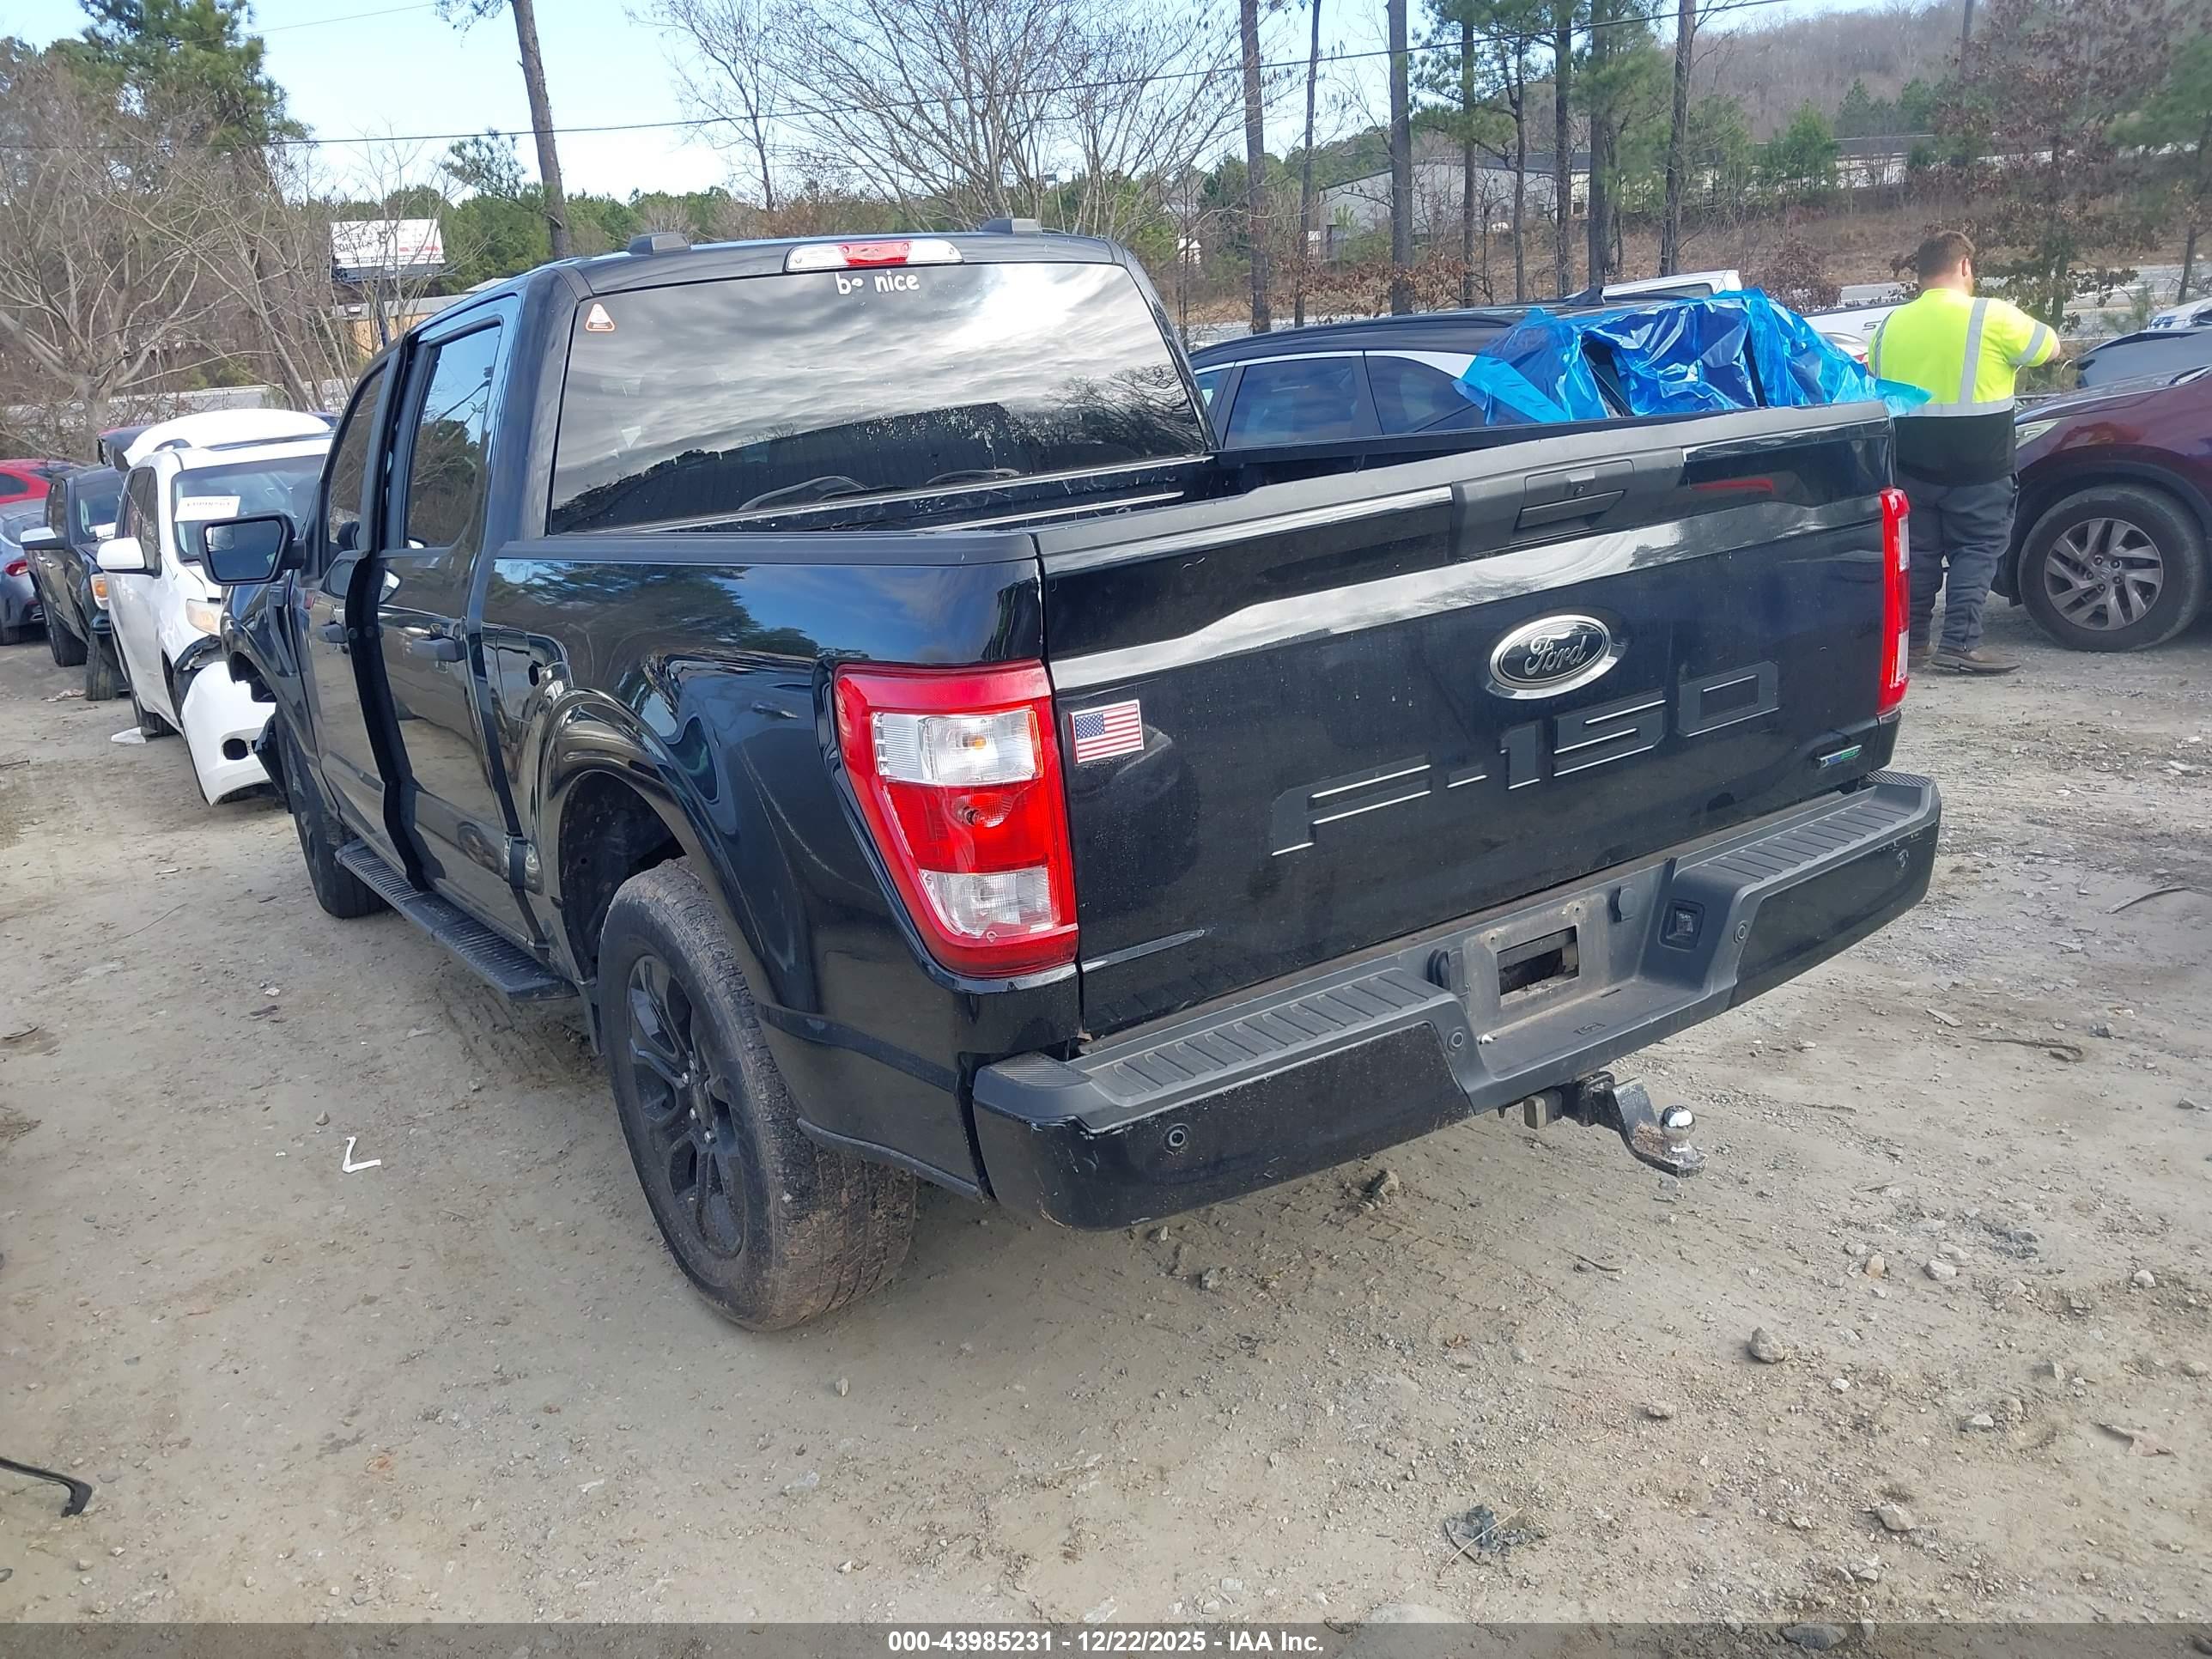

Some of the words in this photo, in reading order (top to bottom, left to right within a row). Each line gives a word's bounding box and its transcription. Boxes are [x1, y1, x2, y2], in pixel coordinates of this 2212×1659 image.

[874, 270, 920, 292] nice
[1524, 631, 1587, 676] Ford
[1272, 659, 1779, 856] F-150
